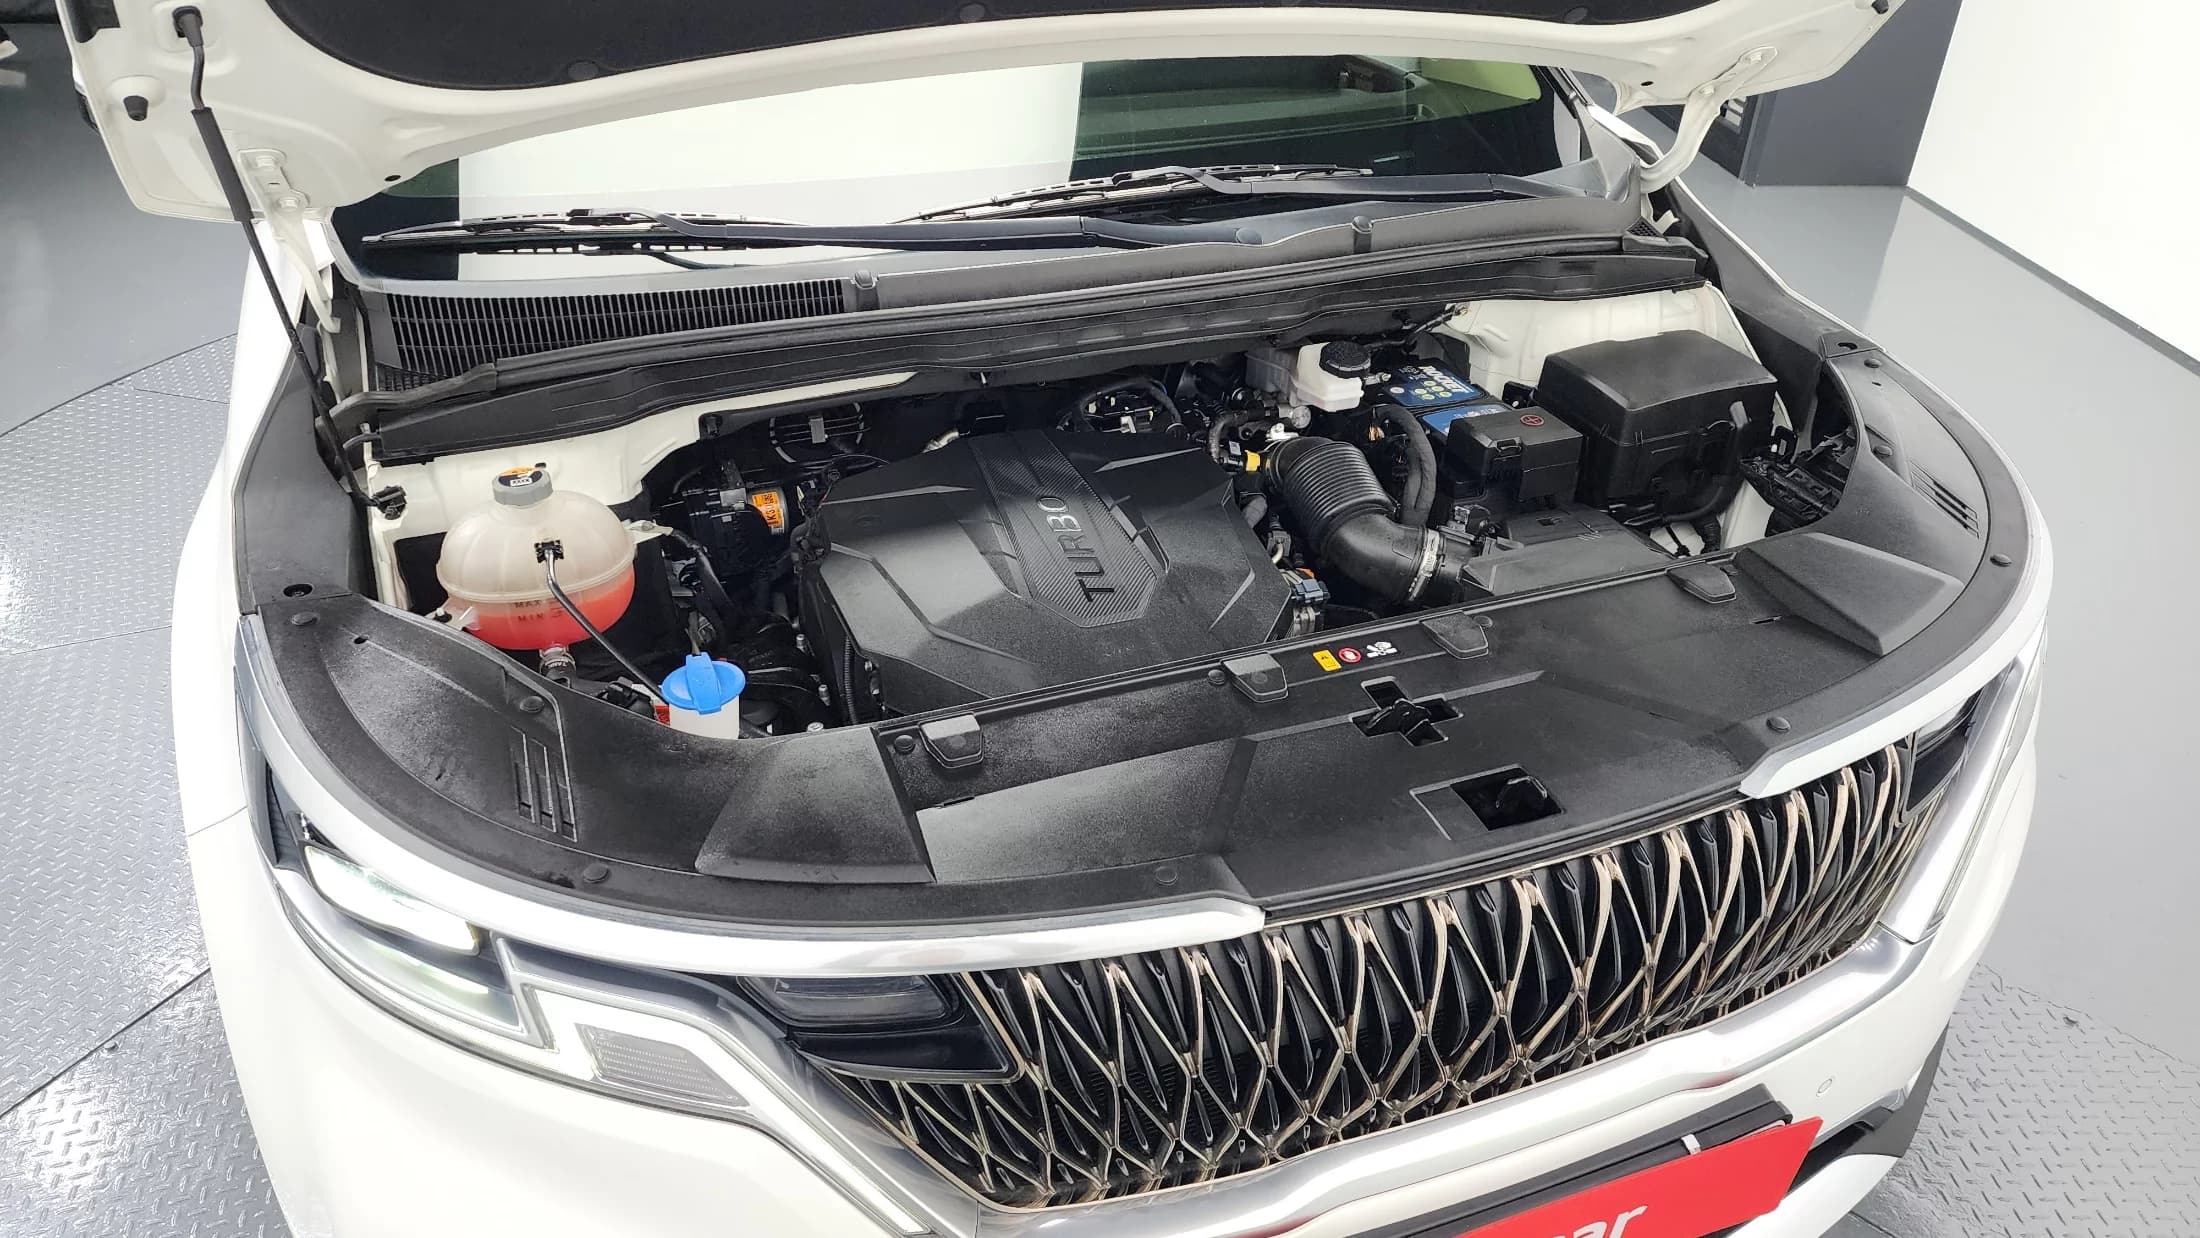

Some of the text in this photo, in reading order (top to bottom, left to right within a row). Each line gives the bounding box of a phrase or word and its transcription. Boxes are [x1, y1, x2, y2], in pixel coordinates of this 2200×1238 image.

[1418, 365, 1469, 393] ROCKET
[1037, 496, 1114, 602] TURBO
[514, 599, 542, 608] MAX
